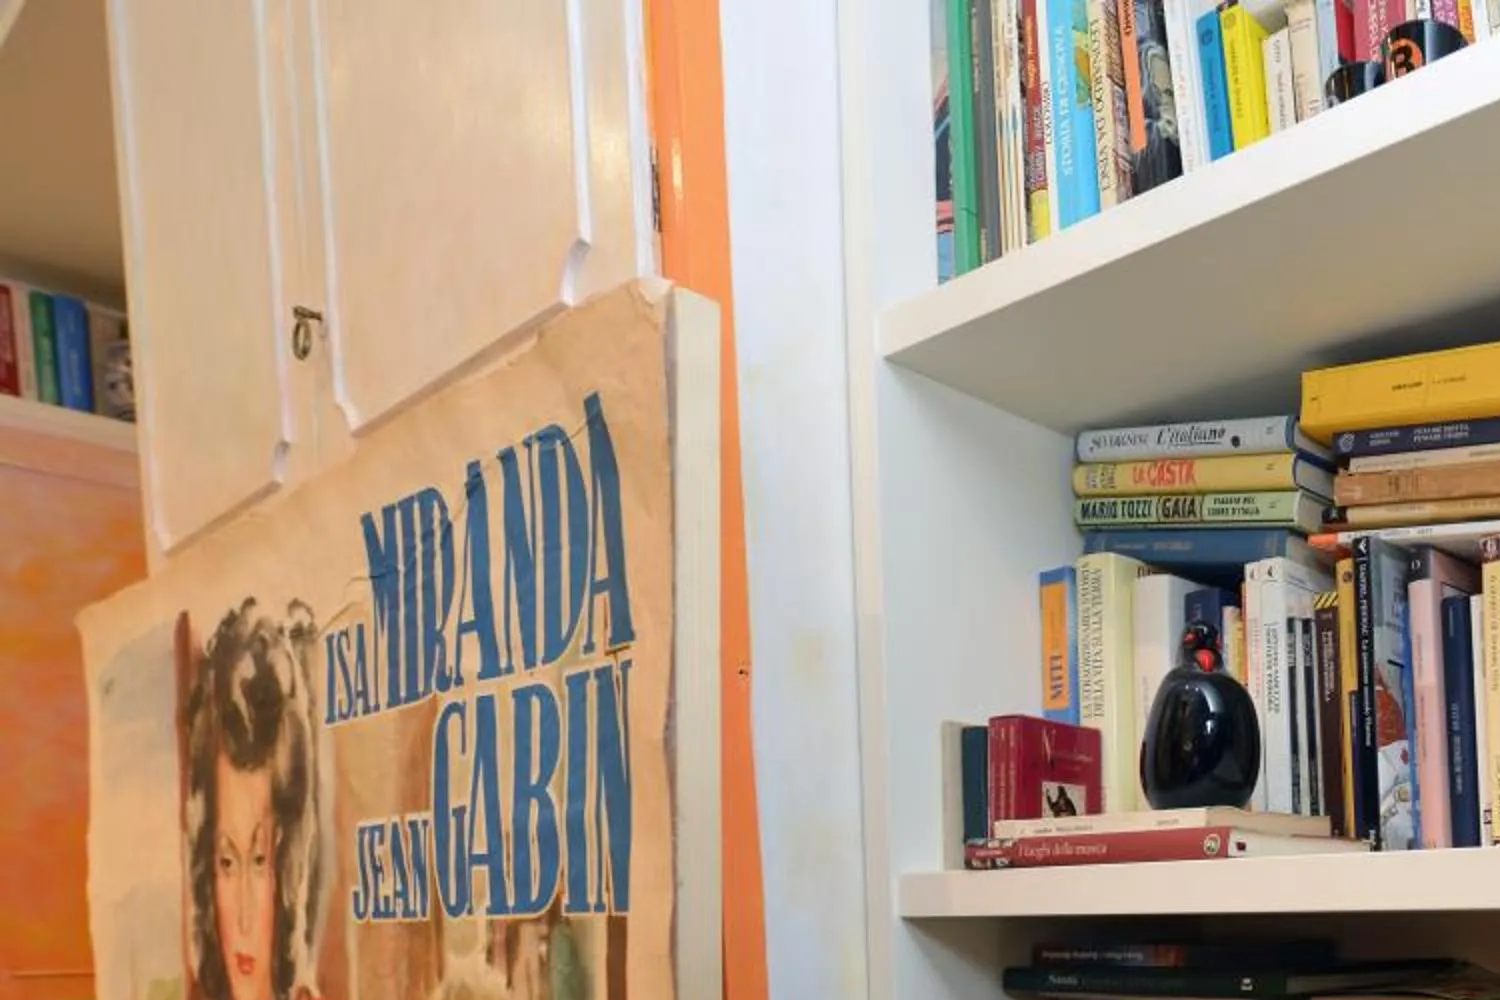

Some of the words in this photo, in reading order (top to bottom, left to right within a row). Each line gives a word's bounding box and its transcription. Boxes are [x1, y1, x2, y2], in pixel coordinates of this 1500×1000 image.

[1149, 459, 1196, 486] CASTA
[1080, 502, 1118, 520] MARIO
[1161, 498, 1198, 519] GAIA
[360, 391, 636, 709] MIRANDA
[352, 817, 430, 921] JEAN
[433, 660, 634, 921] GABIN
